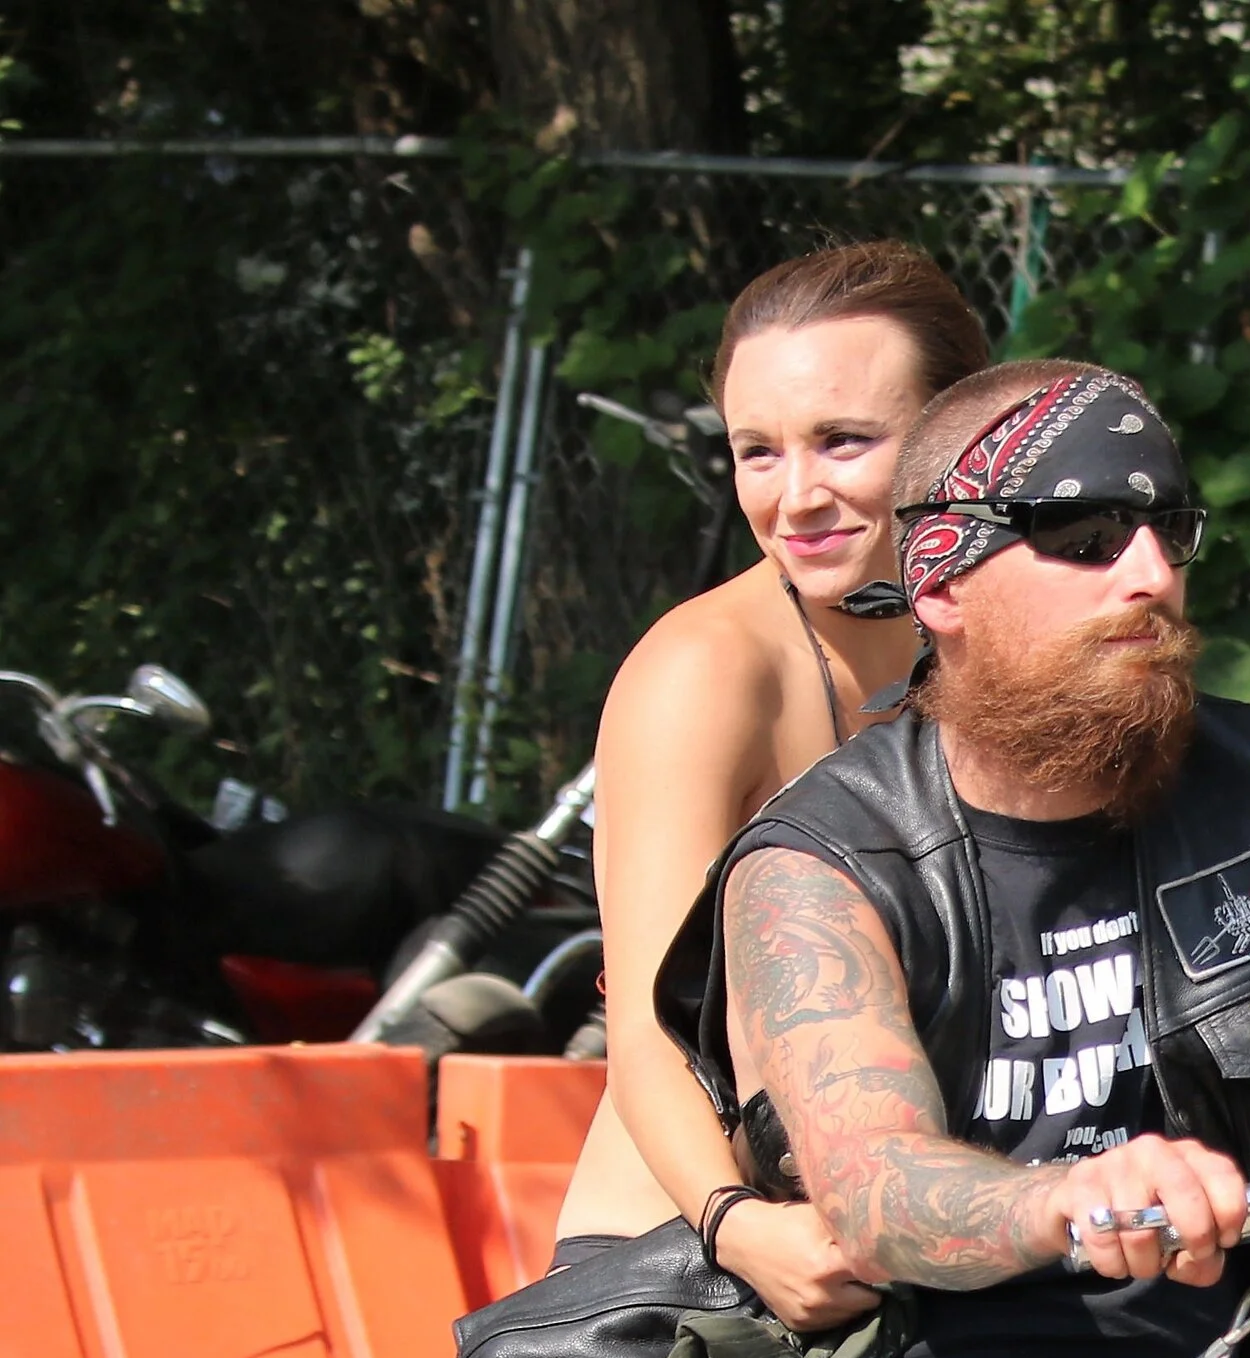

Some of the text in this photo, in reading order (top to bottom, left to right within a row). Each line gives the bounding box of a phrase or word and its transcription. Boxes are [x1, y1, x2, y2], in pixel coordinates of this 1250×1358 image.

[1053, 925, 1093, 956] you
[1092, 911, 1139, 945] don't
[1063, 1126, 1097, 1150] you
